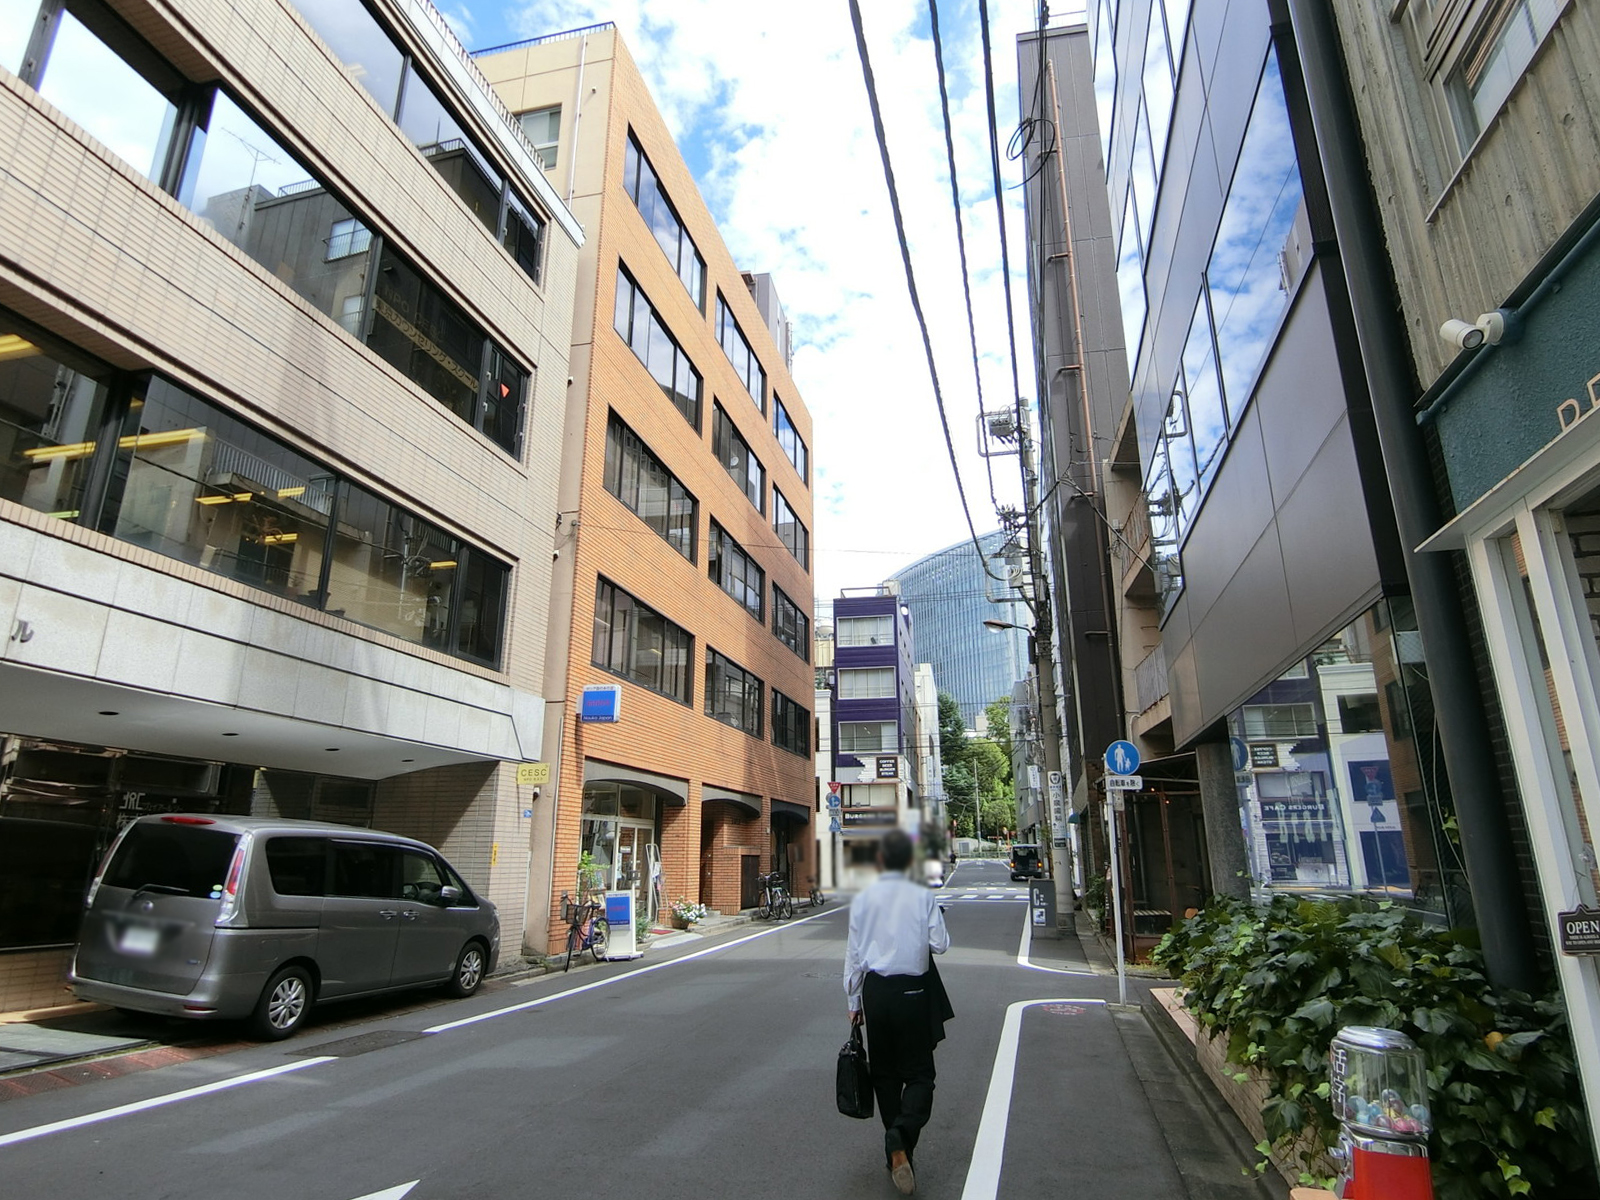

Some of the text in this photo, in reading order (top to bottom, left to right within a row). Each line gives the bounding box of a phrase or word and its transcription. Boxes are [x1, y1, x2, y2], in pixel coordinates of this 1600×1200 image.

[376, 299, 479, 390] 東京カウンセリング・スクール
[1557, 373, 1600, 433] D
[521, 768, 547, 777] CESC
[1109, 779, 1140, 787] 自転車を除く
[1566, 920, 1600, 935] OPEN
